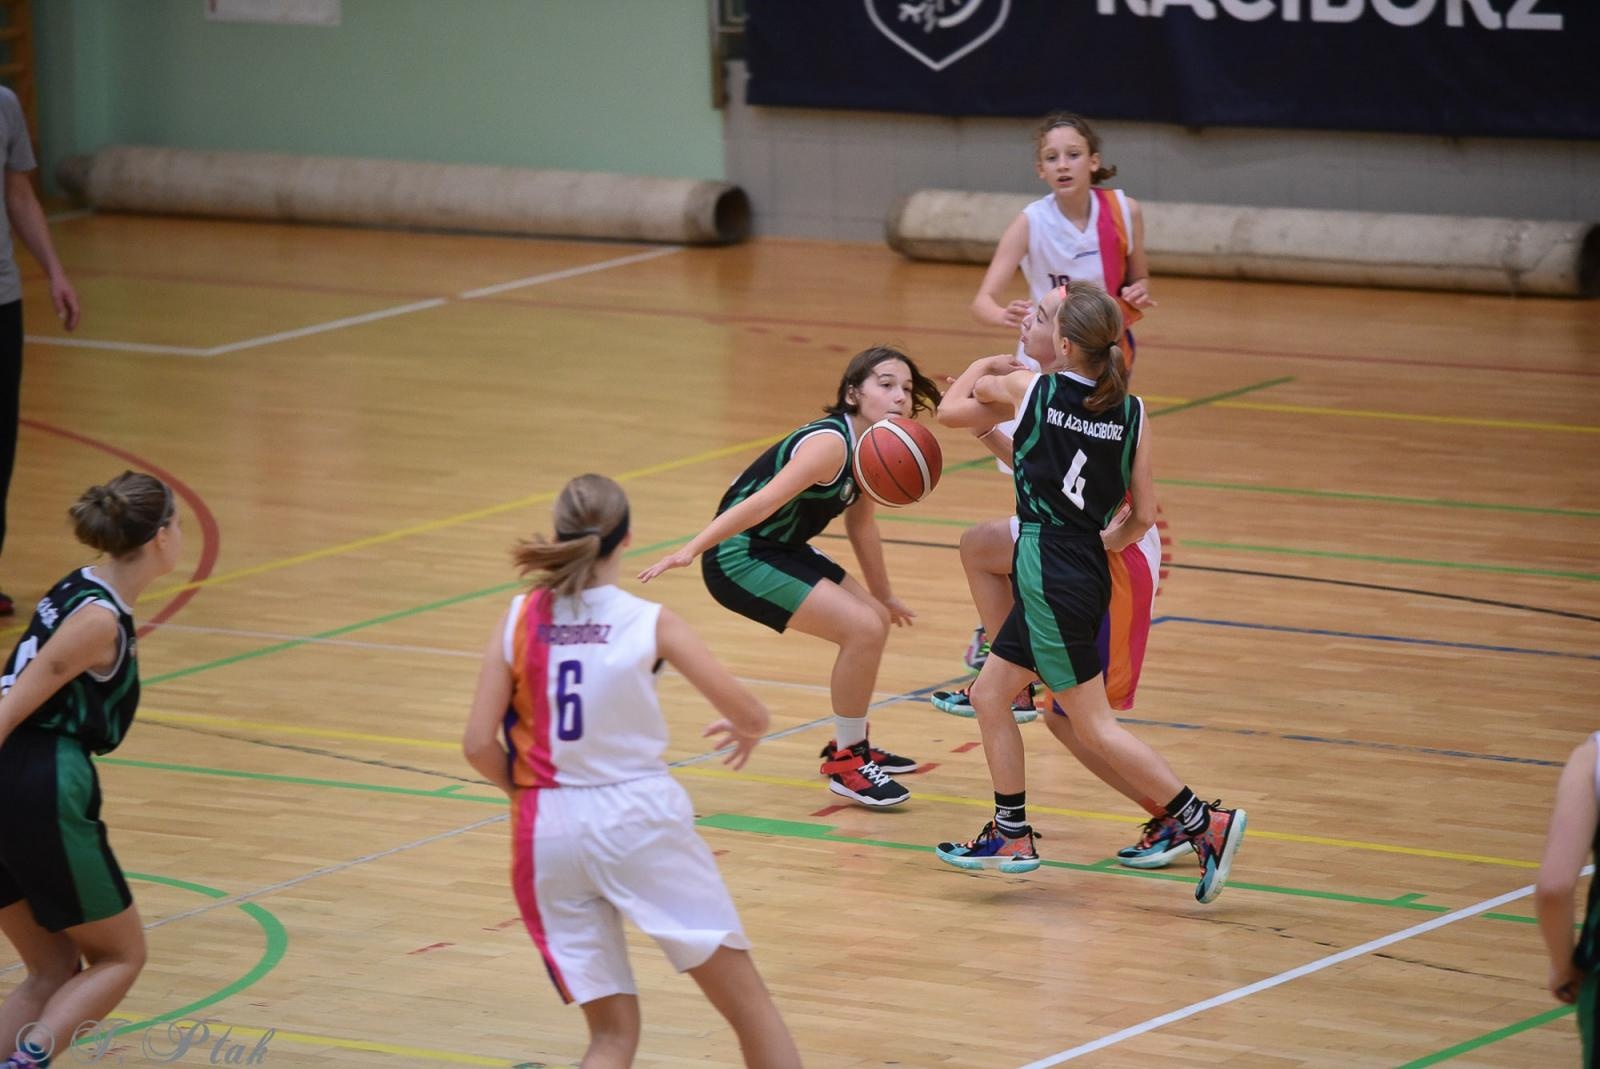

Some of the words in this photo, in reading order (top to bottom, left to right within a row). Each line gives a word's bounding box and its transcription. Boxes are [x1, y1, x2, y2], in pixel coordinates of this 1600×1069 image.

[1046, 407, 1065, 427] RKK
[1061, 448, 1088, 511] 4
[557, 659, 583, 742] 6
